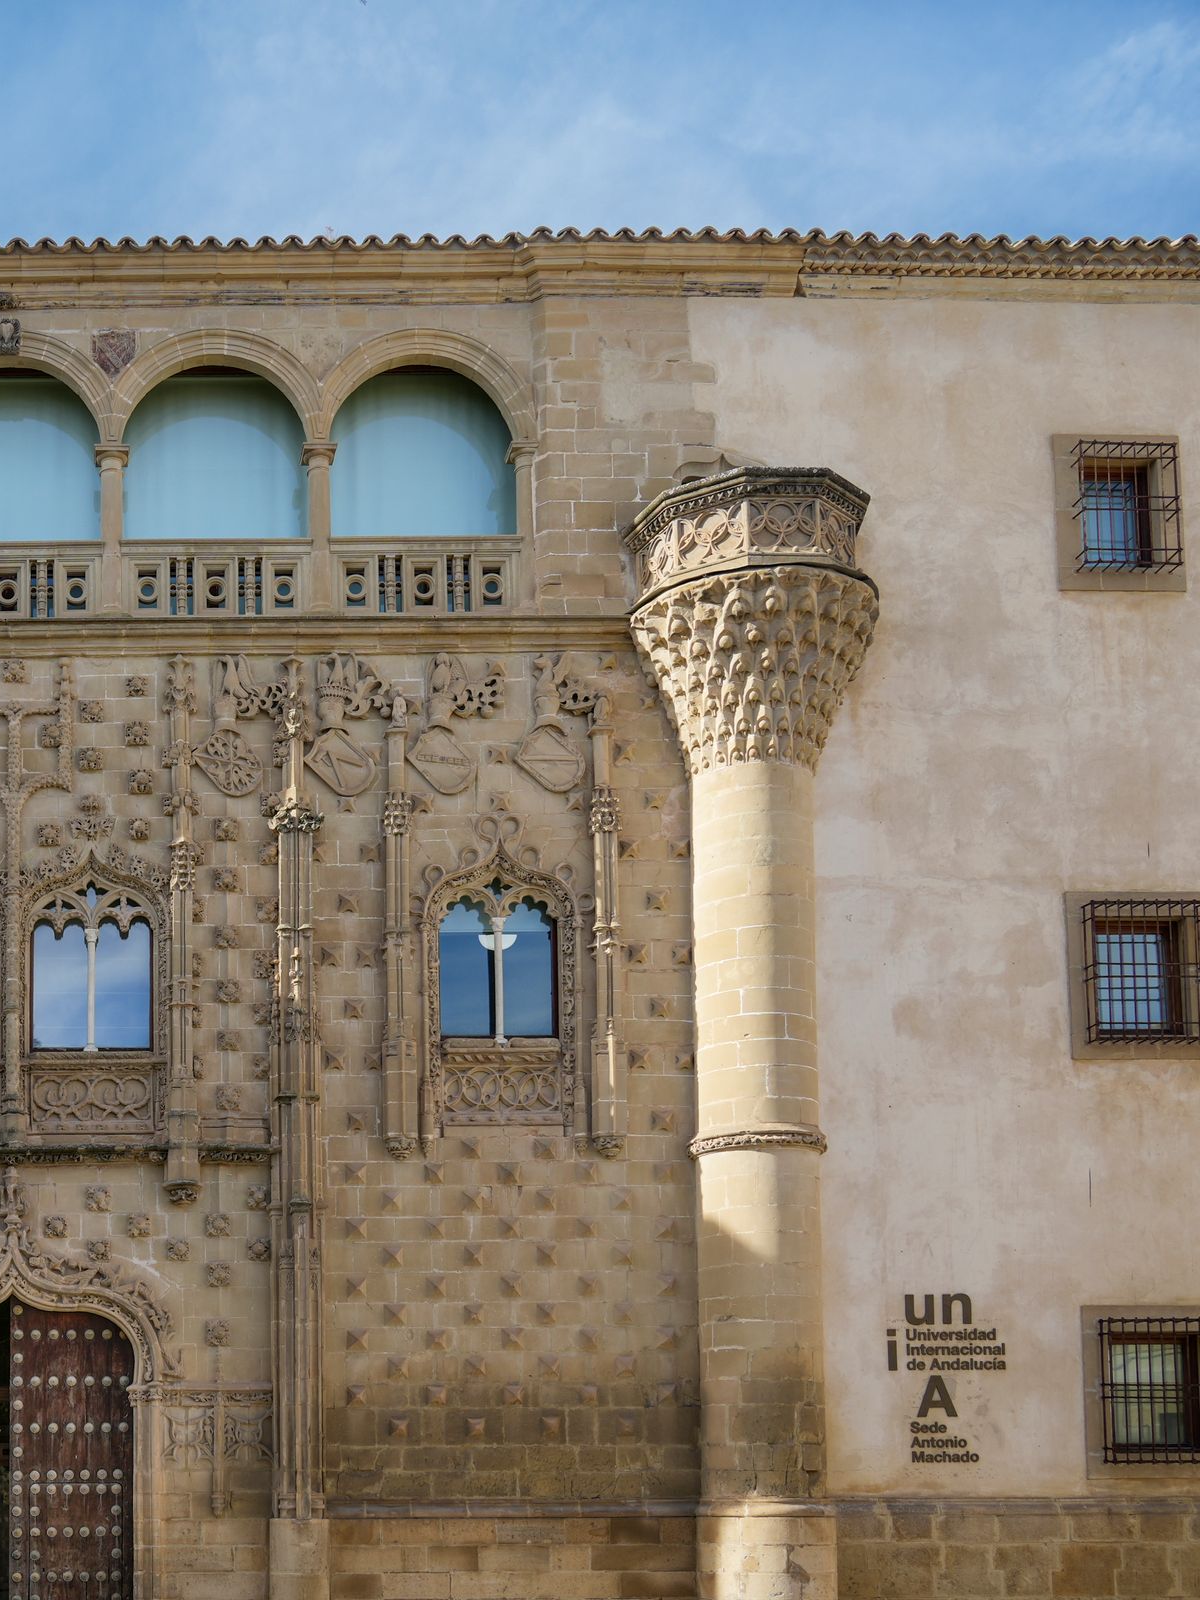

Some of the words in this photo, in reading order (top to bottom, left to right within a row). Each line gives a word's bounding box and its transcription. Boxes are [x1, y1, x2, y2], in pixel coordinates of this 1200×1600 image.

[906, 1328, 996, 1342] Universidad
[906, 1343, 1005, 1356] Internacional
[907, 1358, 926, 1371] de
[929, 1357, 1006, 1371] Andalucía
[917, 1375, 958, 1418] A
[910, 1421, 947, 1434] Sede
[910, 1436, 967, 1449] Antonio
[912, 1450, 979, 1463] Machado
